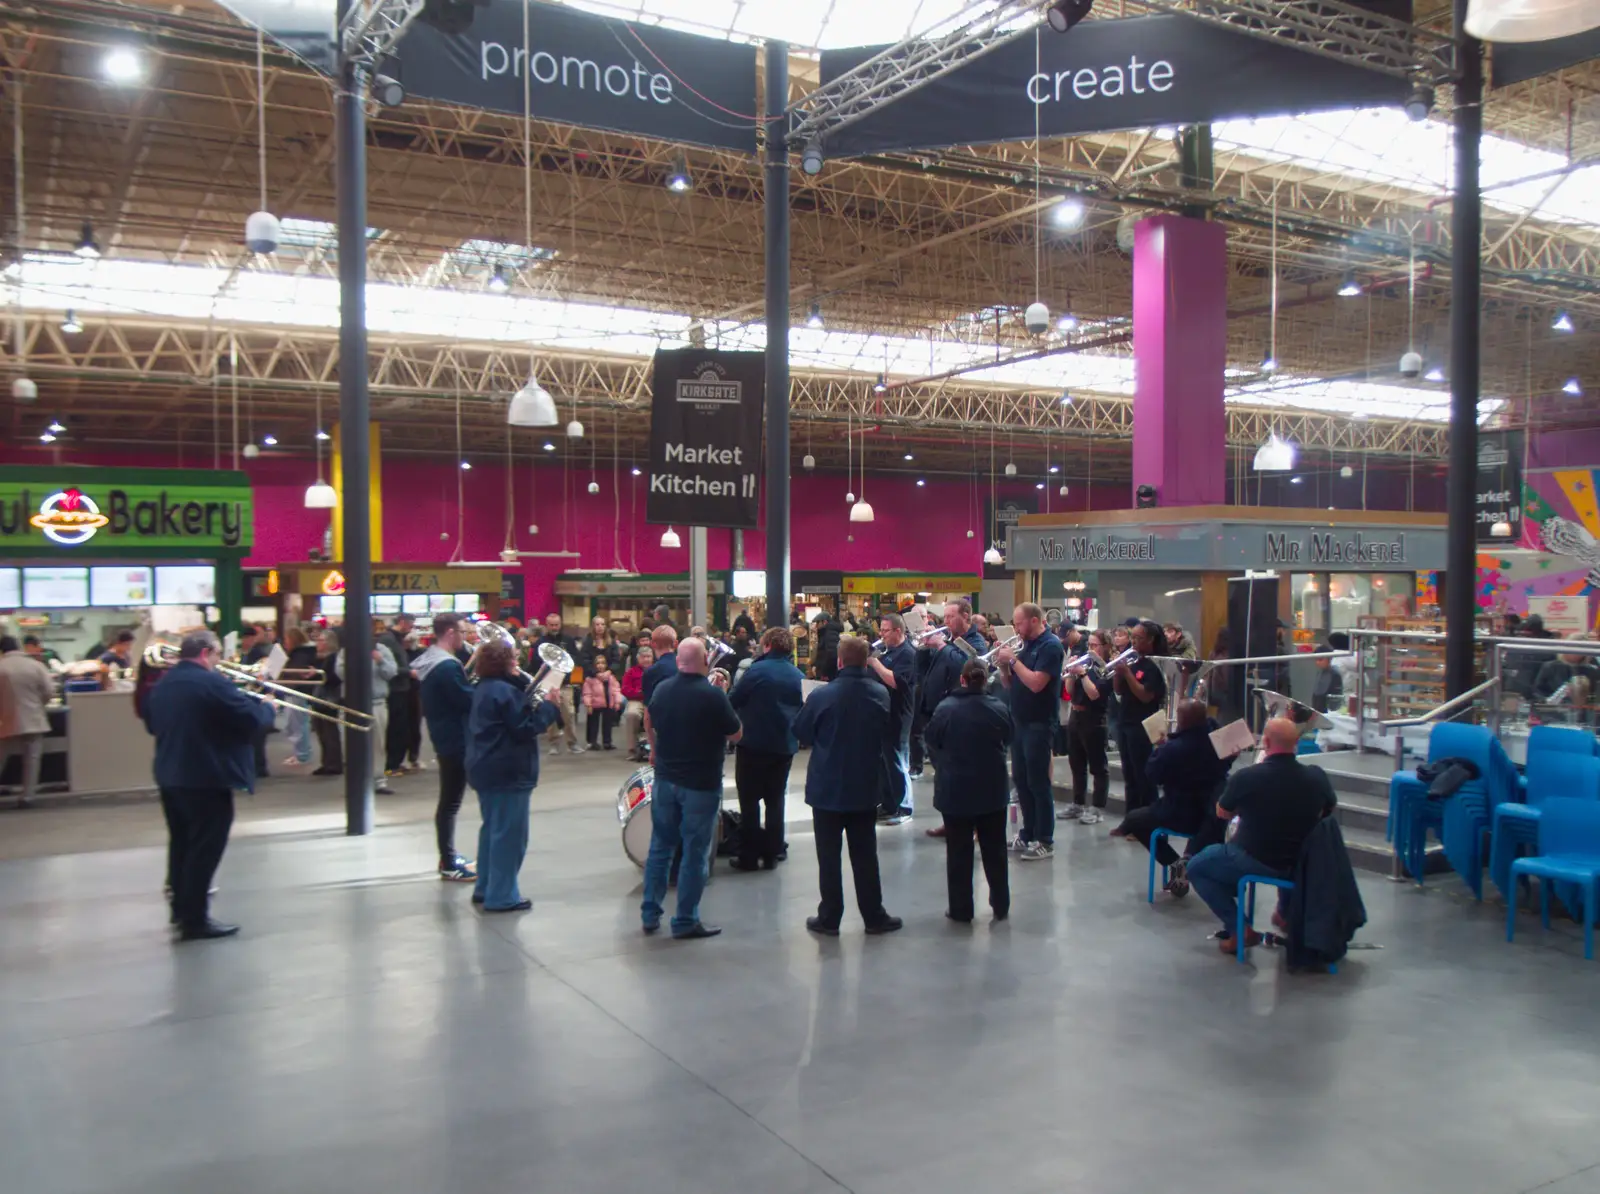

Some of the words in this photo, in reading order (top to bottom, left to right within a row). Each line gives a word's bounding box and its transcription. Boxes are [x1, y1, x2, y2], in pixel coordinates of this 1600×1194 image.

[481, 40, 673, 104] promote
[1026, 55, 1174, 104] create
[681, 384, 737, 399] KIRKGATE
[665, 442, 743, 465] Market
[650, 473, 736, 497] Kitchen
[1476, 490, 1511, 504] arket
[0, 489, 31, 536] ul
[109, 489, 241, 546] Bakery
[1476, 510, 1508, 523] chen
[373, 574, 441, 591] EZIZA
